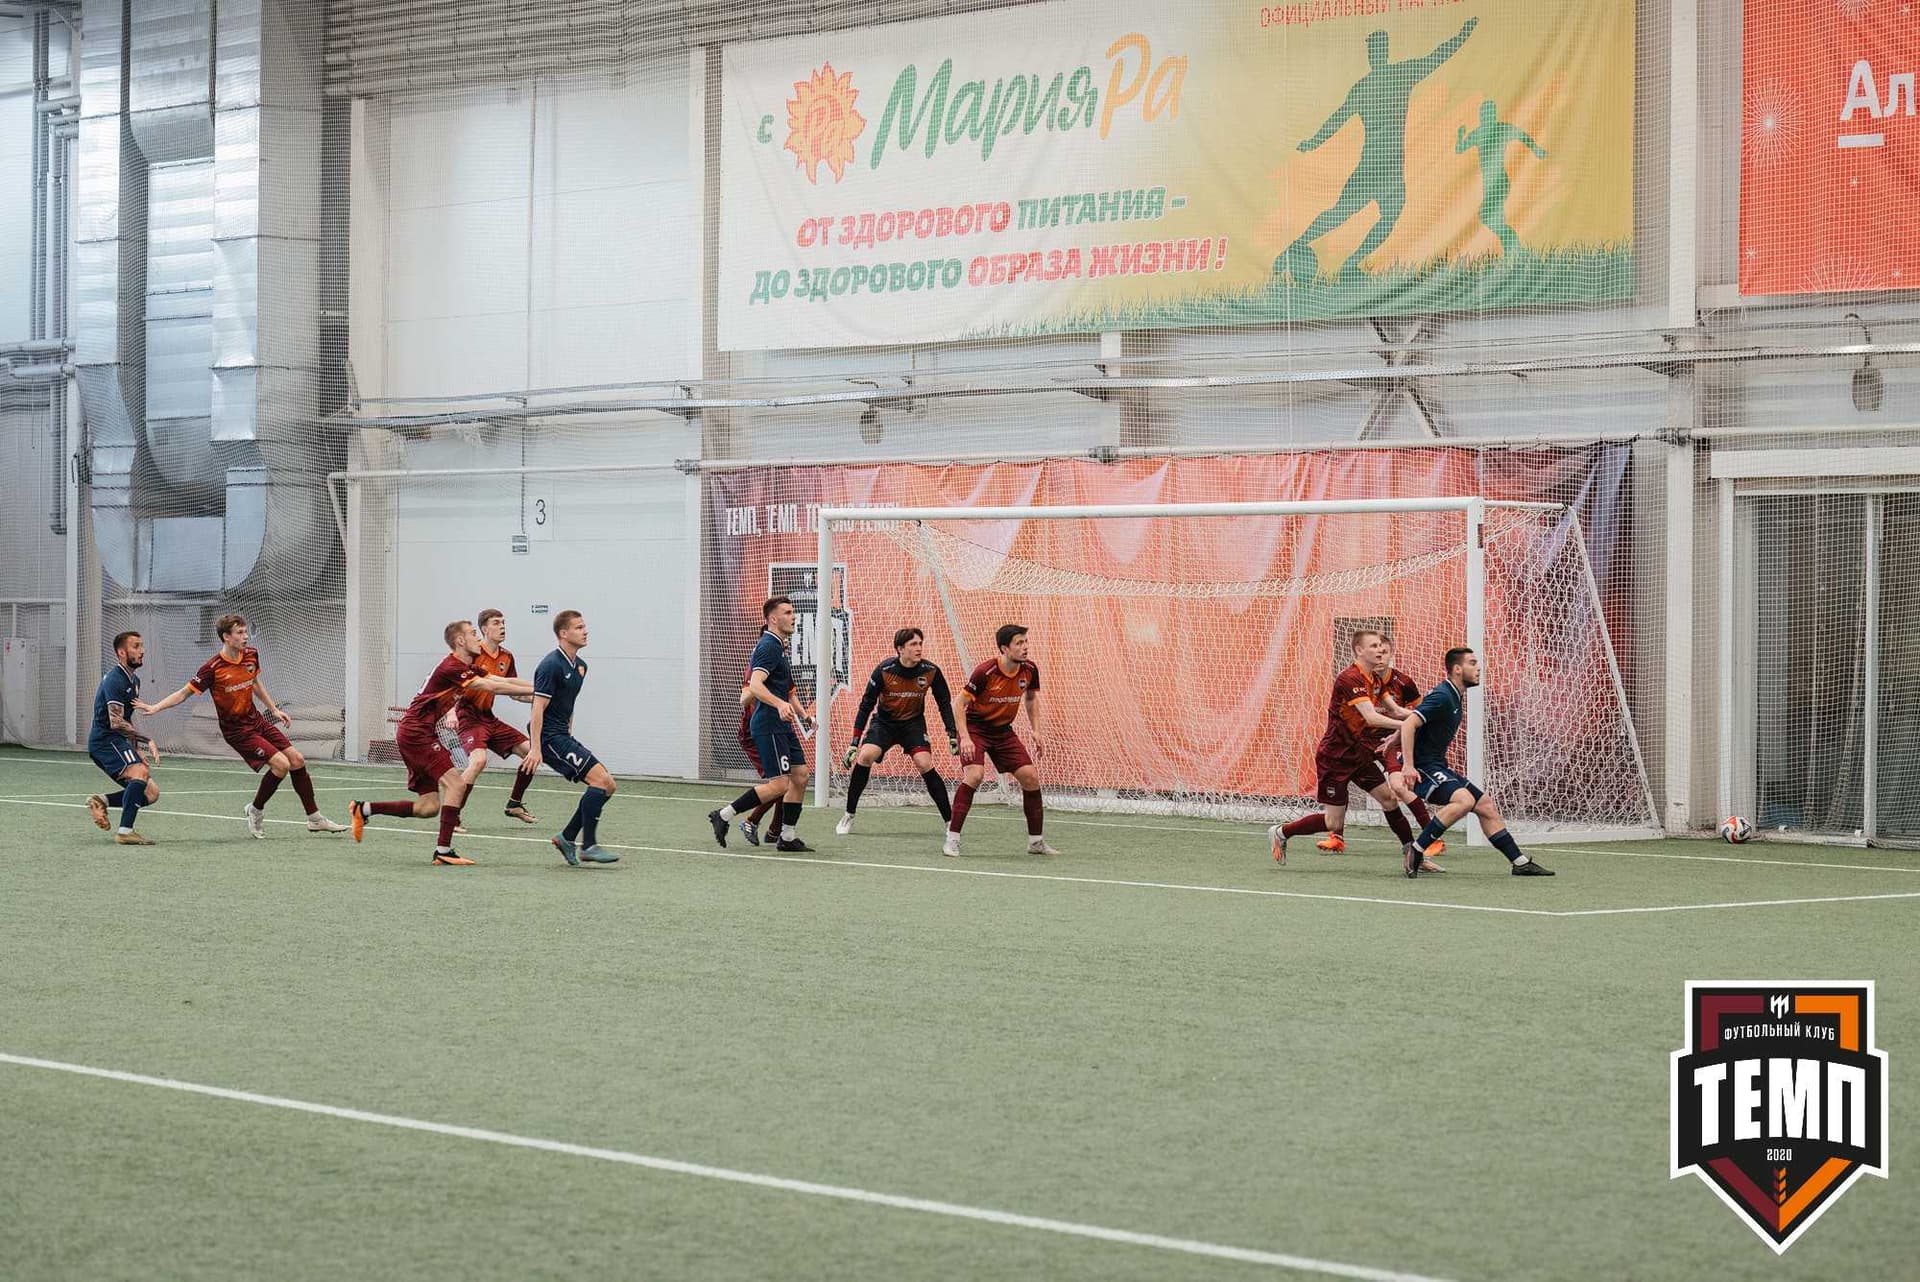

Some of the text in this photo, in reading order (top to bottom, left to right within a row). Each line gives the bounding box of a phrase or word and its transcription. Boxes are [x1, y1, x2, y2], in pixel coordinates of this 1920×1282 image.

[796, 216, 834, 248] ОТ
[838, 201, 1011, 250] ЗДОРОВОГО
[1016, 186, 1167, 230] ПИТАНИЯ
[749, 268, 791, 305] ДО
[793, 257, 962, 303] ЗДОРОВОГО
[967, 247, 1082, 287] ОБРАЗА
[535, 498, 546, 525] 3
[123, 749, 136, 764] 11
[565, 752, 584, 767] 2
[780, 755, 790, 771] 6
[1433, 771, 1448, 785] 3
